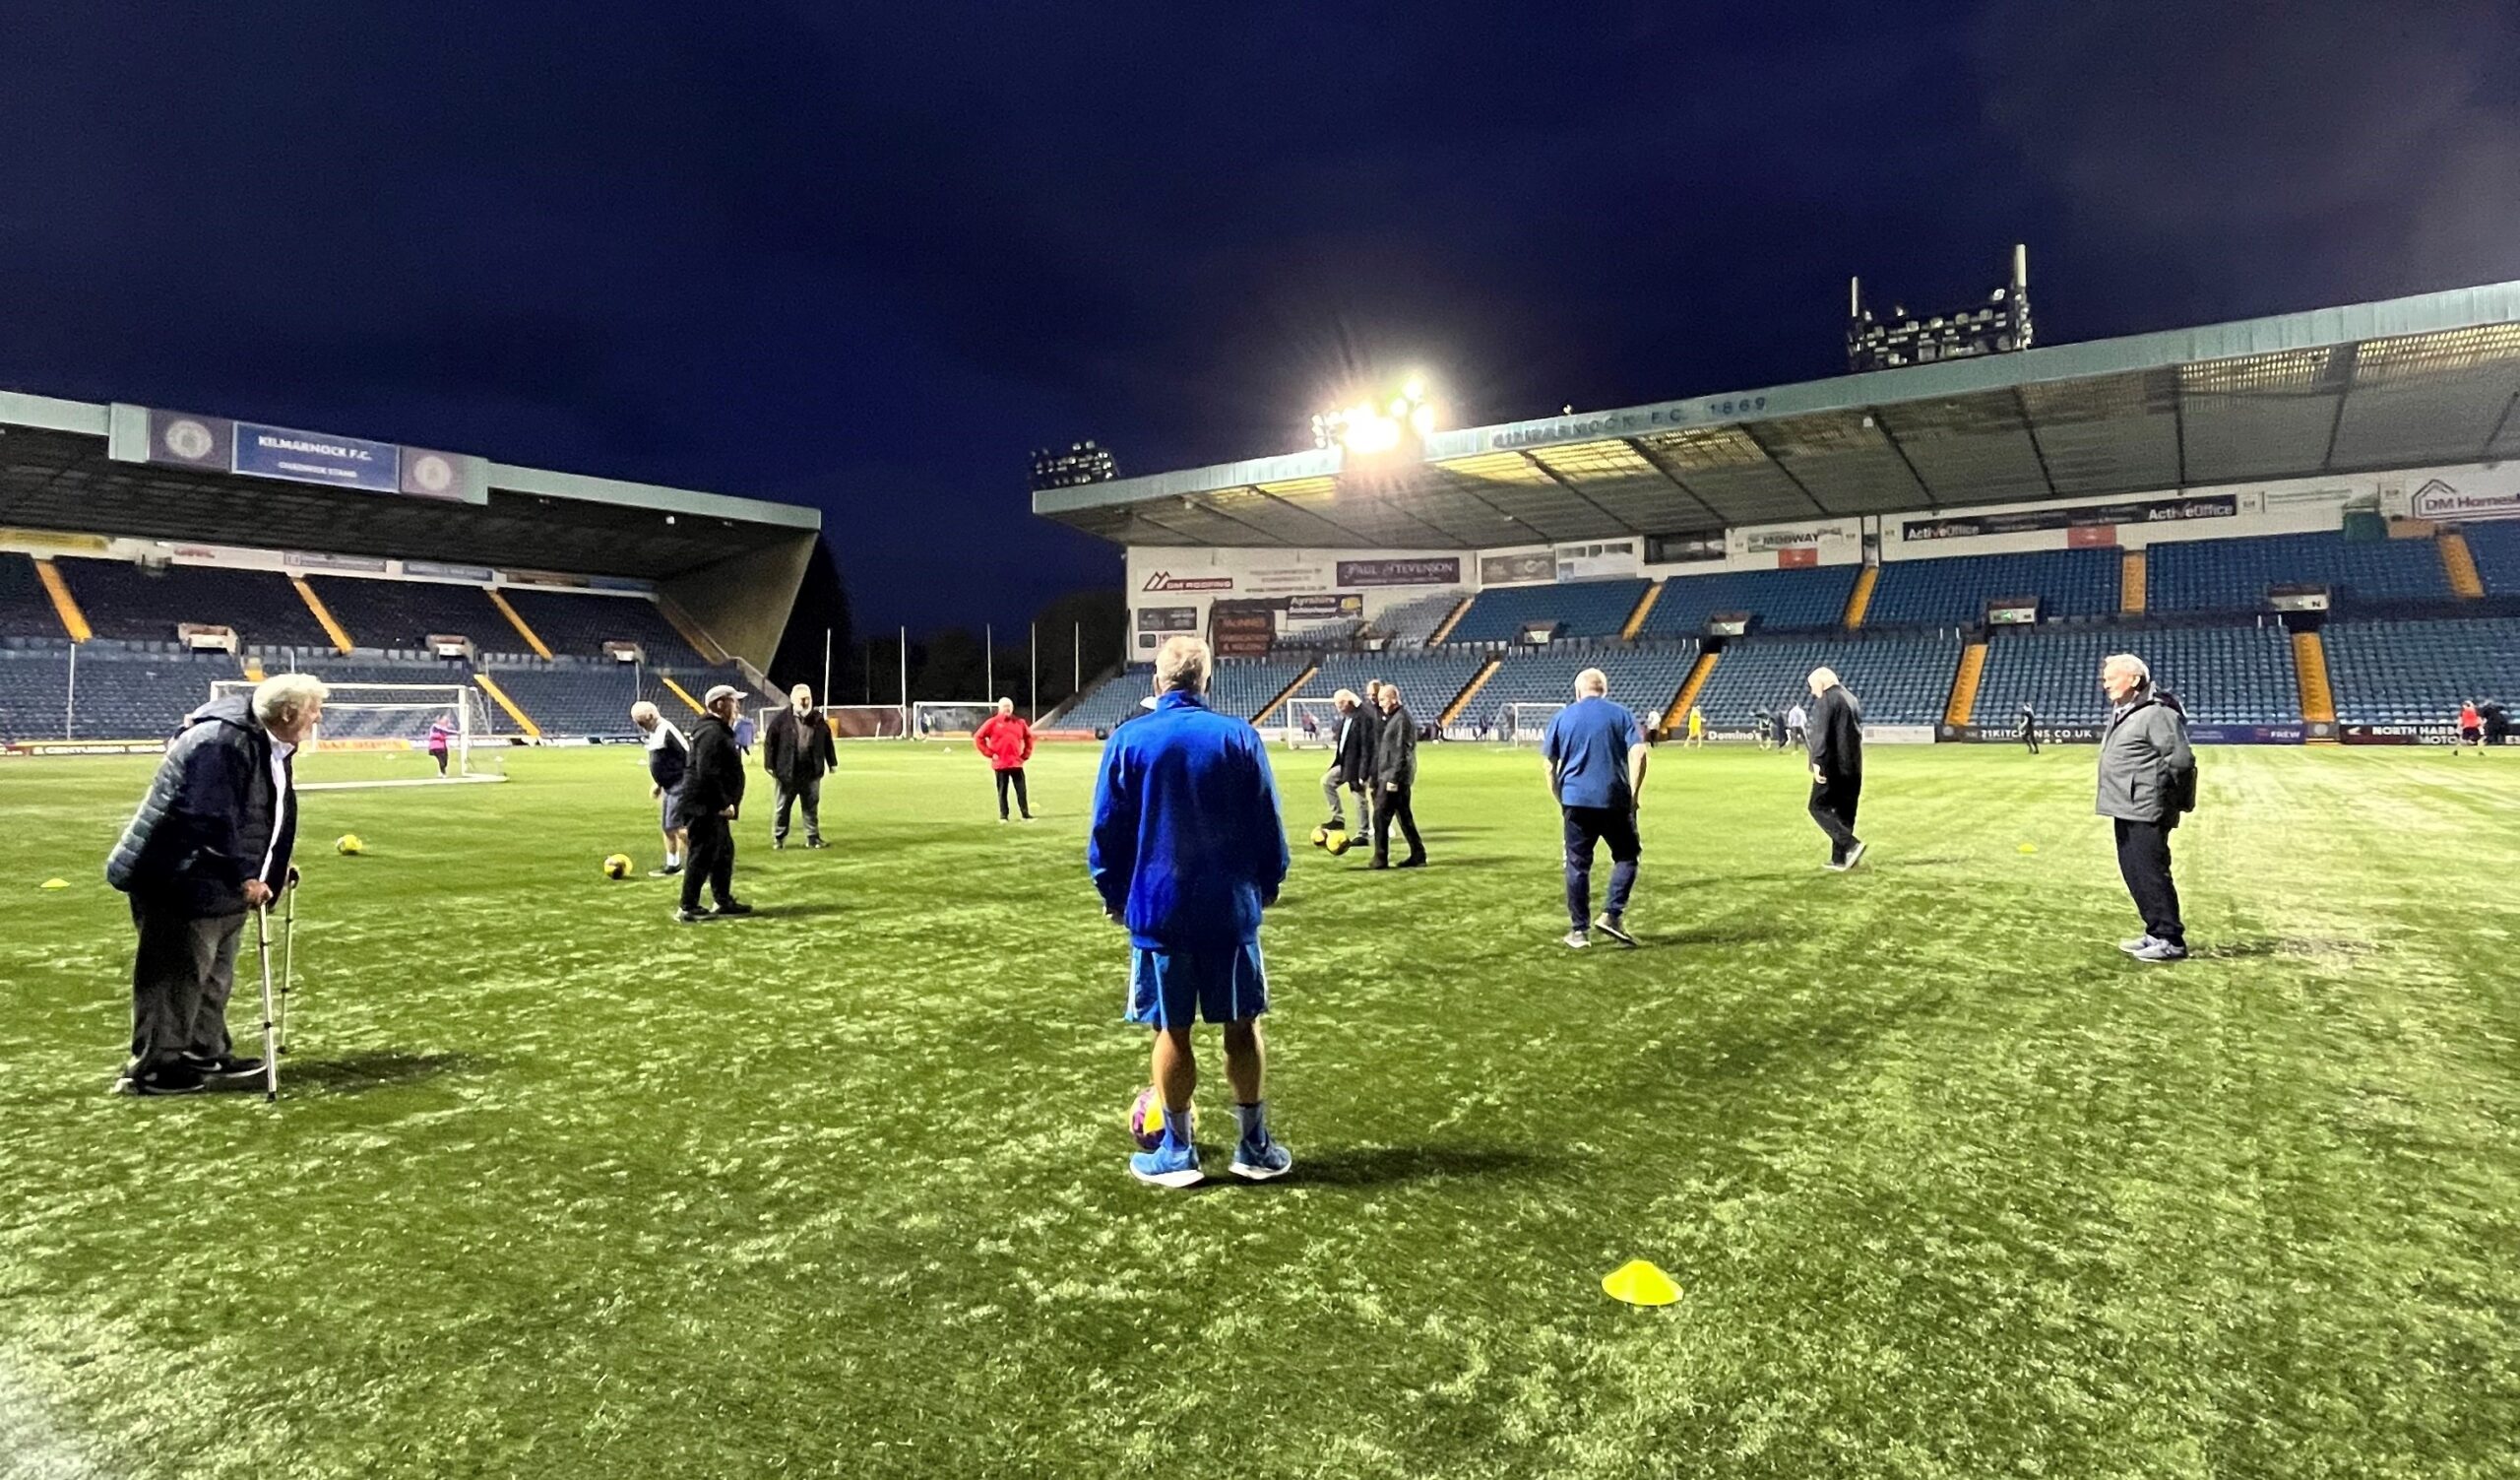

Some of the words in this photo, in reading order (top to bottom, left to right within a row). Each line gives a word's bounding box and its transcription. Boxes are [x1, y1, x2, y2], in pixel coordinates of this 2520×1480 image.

[1710, 396, 1766, 414] 1869
[258, 435, 346, 458] KILMARNOCK
[2148, 503, 2234, 521] ActiveOffice
[1907, 522, 1981, 540] ActiveOffice
[2372, 726, 2417, 736] NORTH
